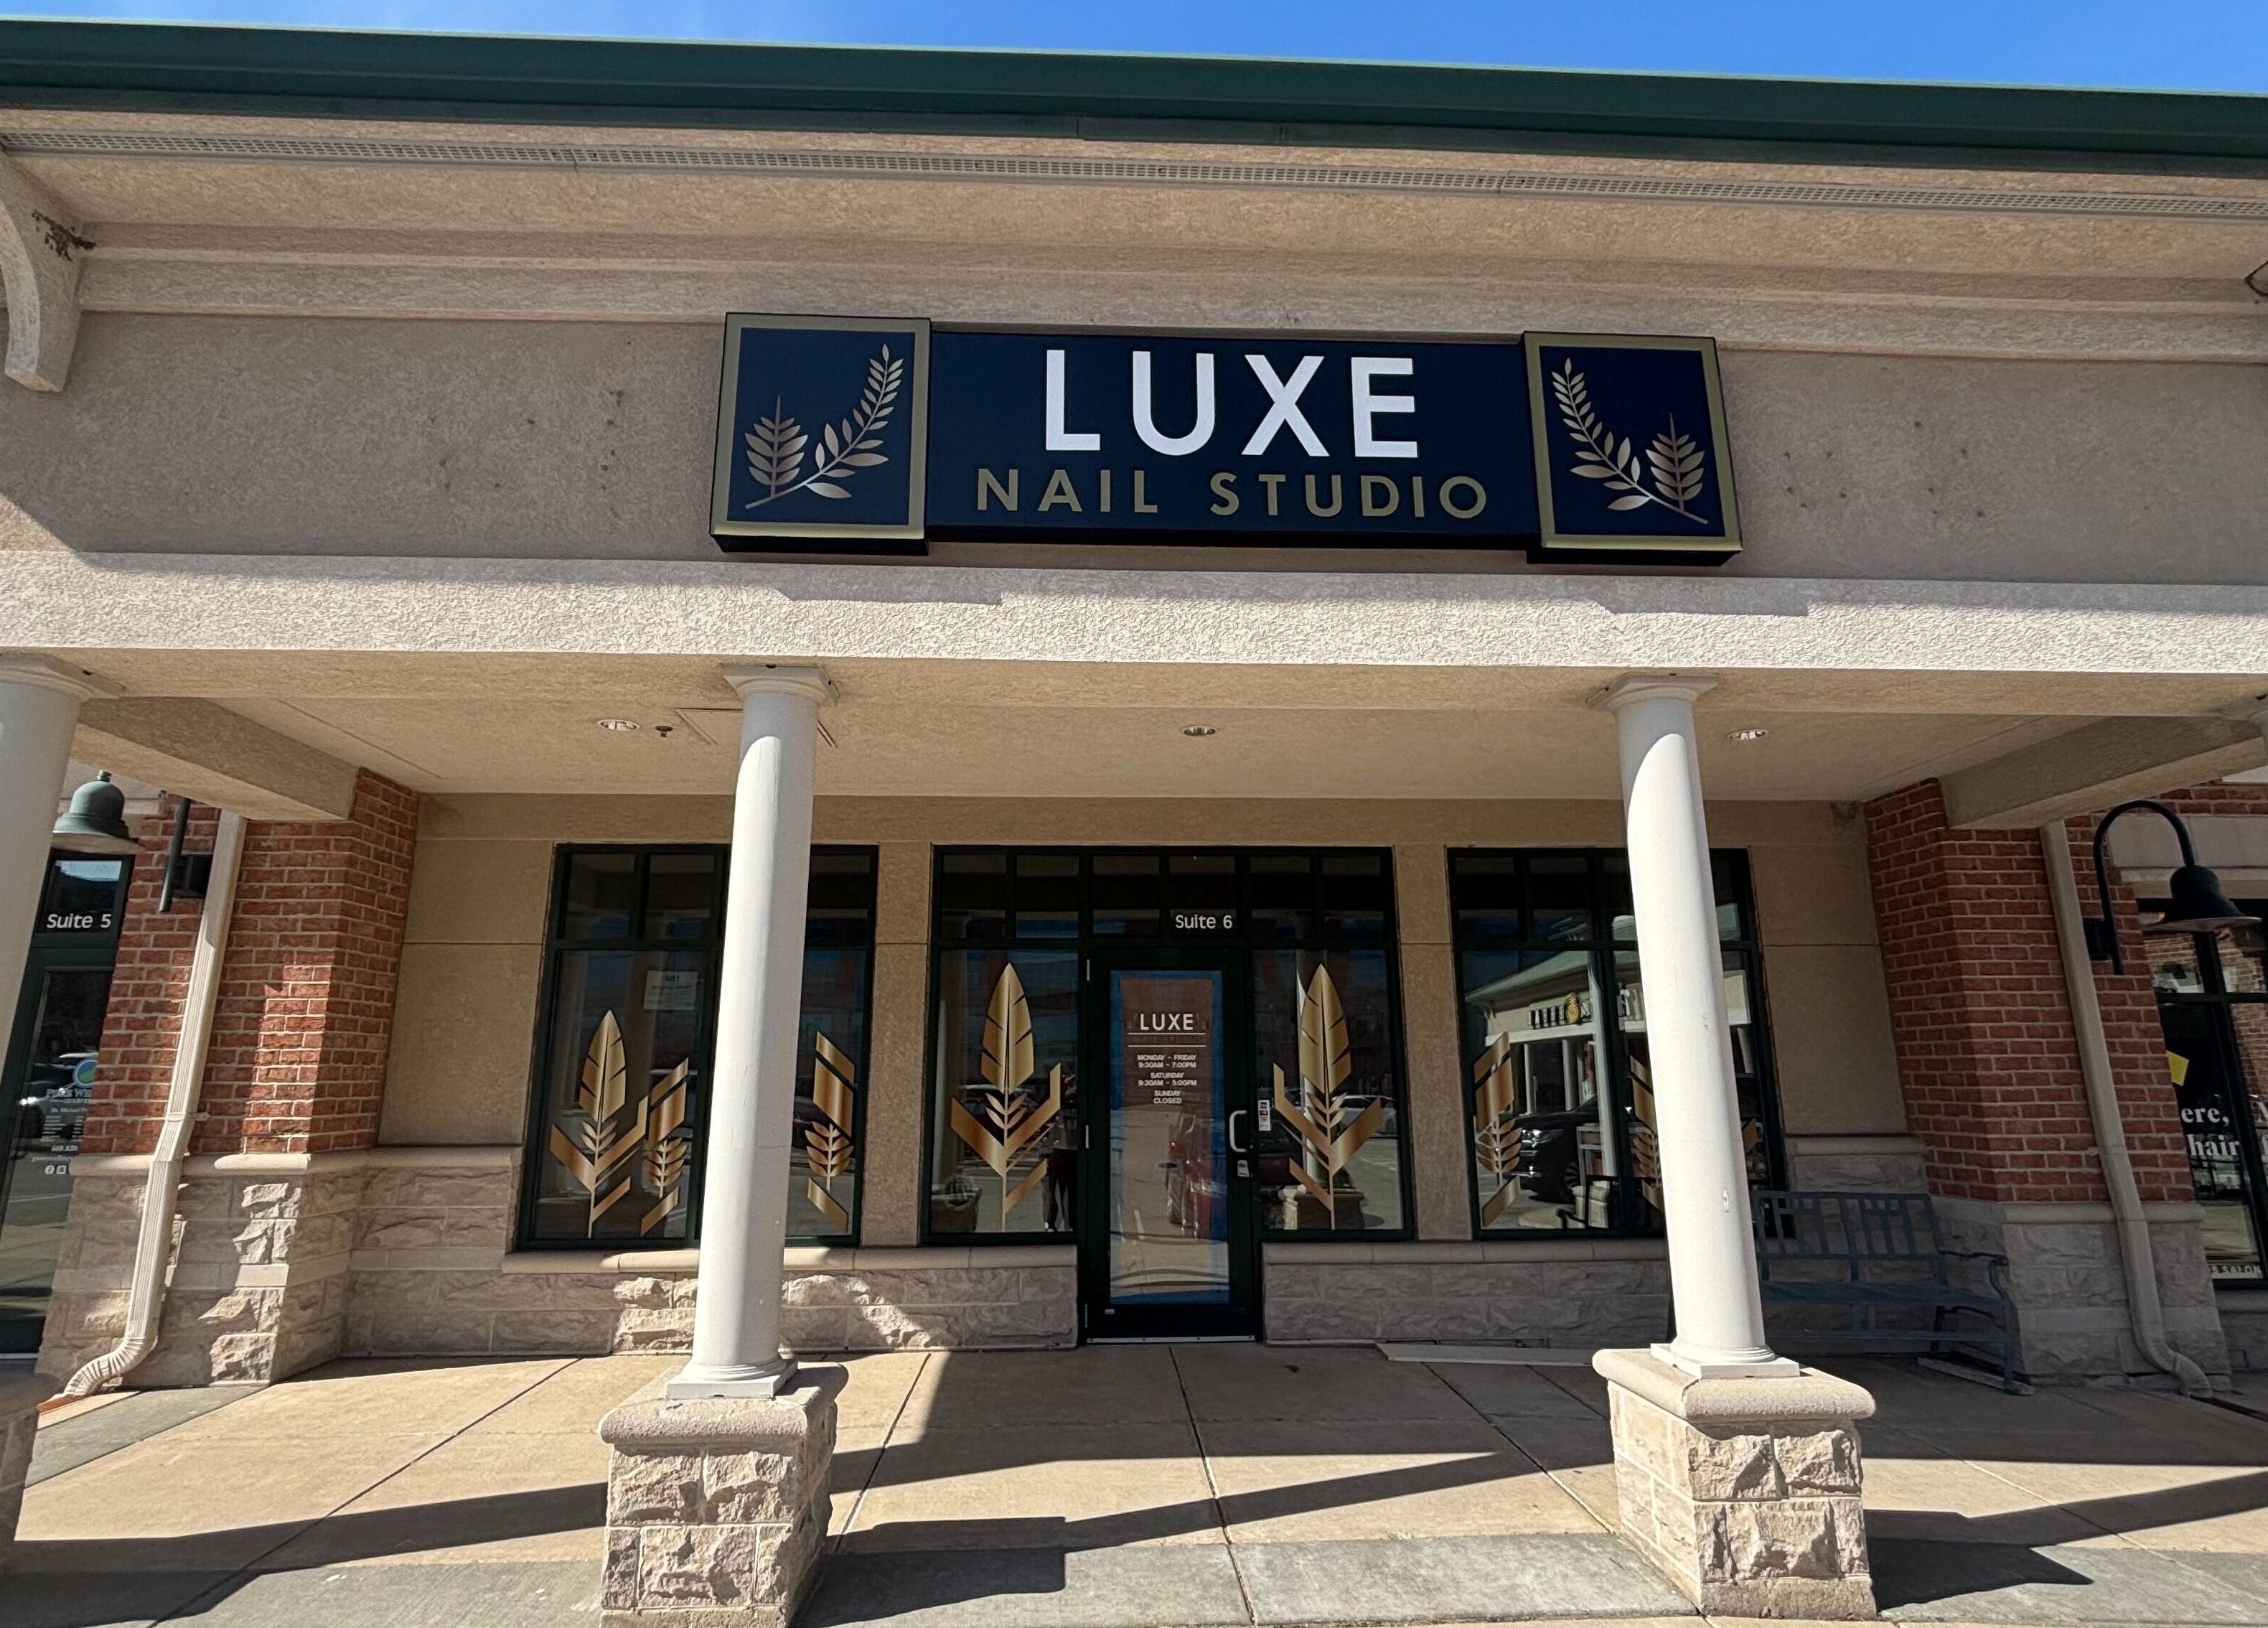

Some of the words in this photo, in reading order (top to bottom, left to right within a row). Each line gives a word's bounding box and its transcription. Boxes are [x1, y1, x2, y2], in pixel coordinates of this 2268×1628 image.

[1045, 349, 1418, 459] LUXE
[977, 468, 1158, 514] NAIL
[1209, 472, 1487, 519] STUDIO
[46, 913, 93, 929] Suite
[100, 914, 112, 928] 5
[1175, 914, 1217, 930] Suite
[1223, 914, 1233, 930] 6
[1140, 1014, 1193, 1030] LUXE
[2186, 1133, 2240, 1156] hair
